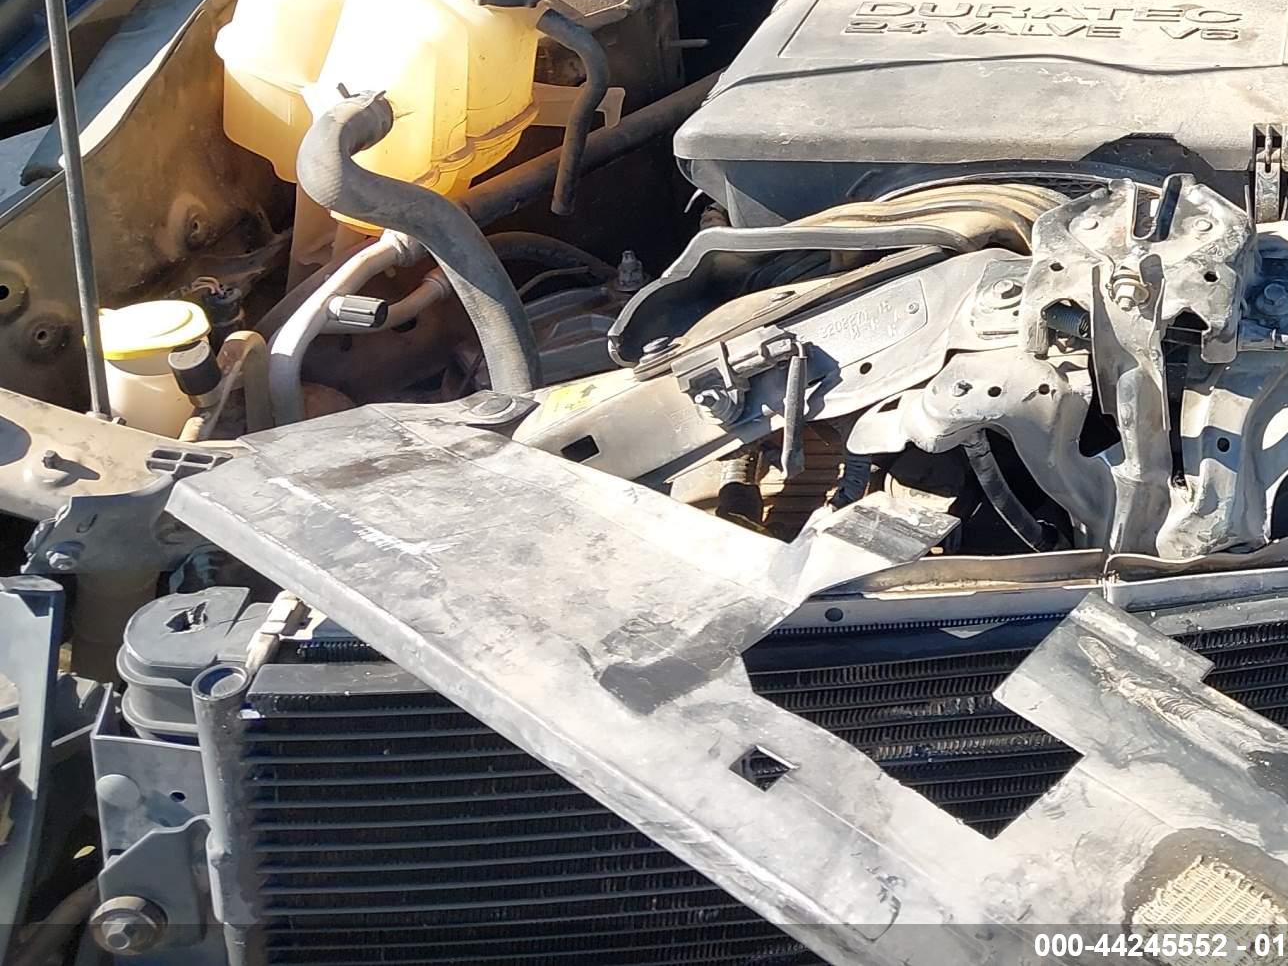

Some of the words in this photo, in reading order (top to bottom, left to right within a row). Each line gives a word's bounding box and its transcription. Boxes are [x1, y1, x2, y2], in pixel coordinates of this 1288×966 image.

[856, 1, 1243, 24] DURATEC
[845, 20, 928, 35] 24
[946, 21, 1124, 38] VALVE
[1158, 25, 1240, 41] V6
